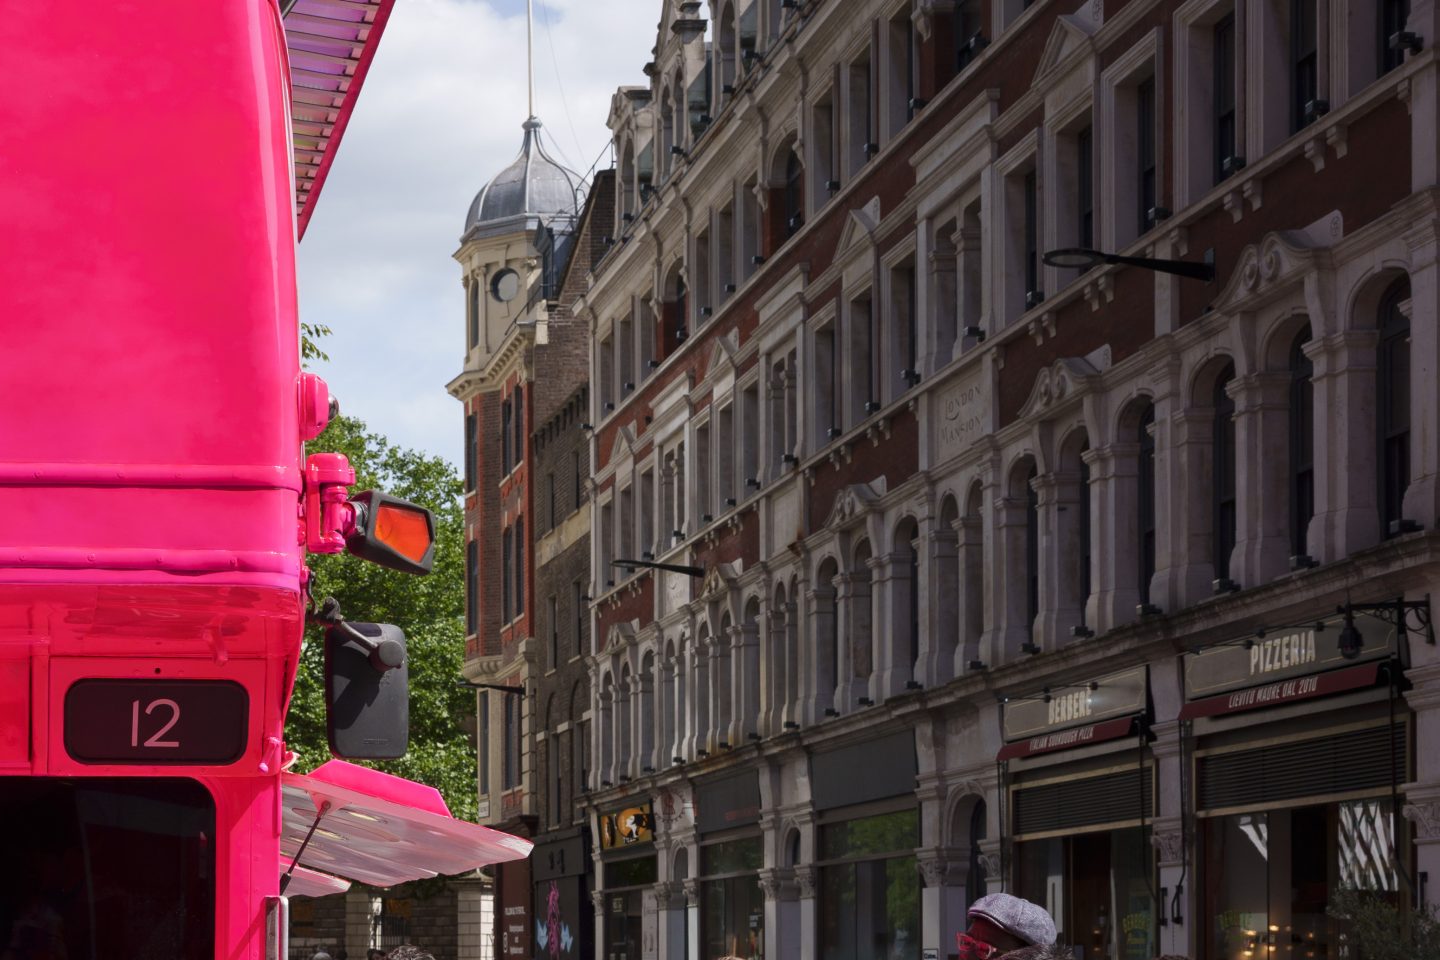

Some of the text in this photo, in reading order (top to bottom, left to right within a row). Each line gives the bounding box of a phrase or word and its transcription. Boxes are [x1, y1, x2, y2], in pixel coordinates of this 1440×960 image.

[1250, 630, 1317, 676] PIZZERIA
[1256, 684, 1281, 704] MADRE
[1282, 681, 1297, 698] DAL
[130, 697, 181, 748] 12
